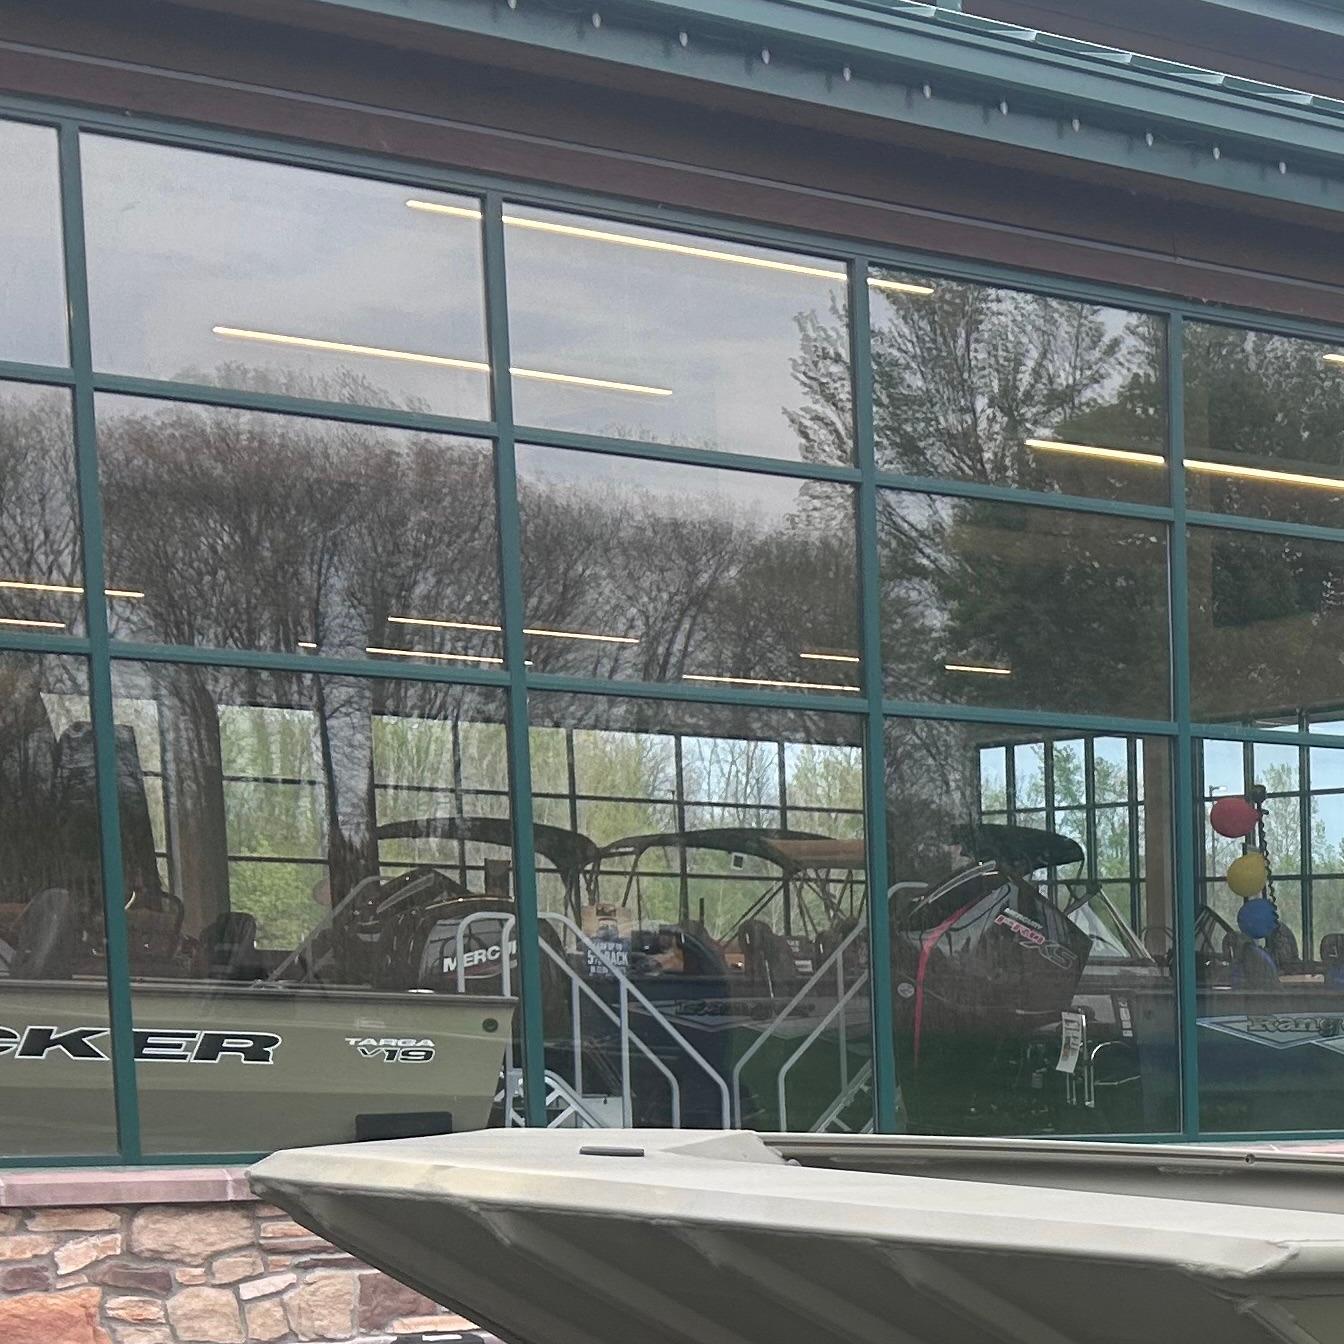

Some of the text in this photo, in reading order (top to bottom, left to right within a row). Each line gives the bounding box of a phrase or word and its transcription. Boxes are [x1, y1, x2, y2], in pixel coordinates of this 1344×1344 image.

[443, 939, 518, 973] MERC
[0, 1025, 283, 1065] KER
[344, 1037, 436, 1047] TARGA
[357, 1046, 436, 1064] V19
